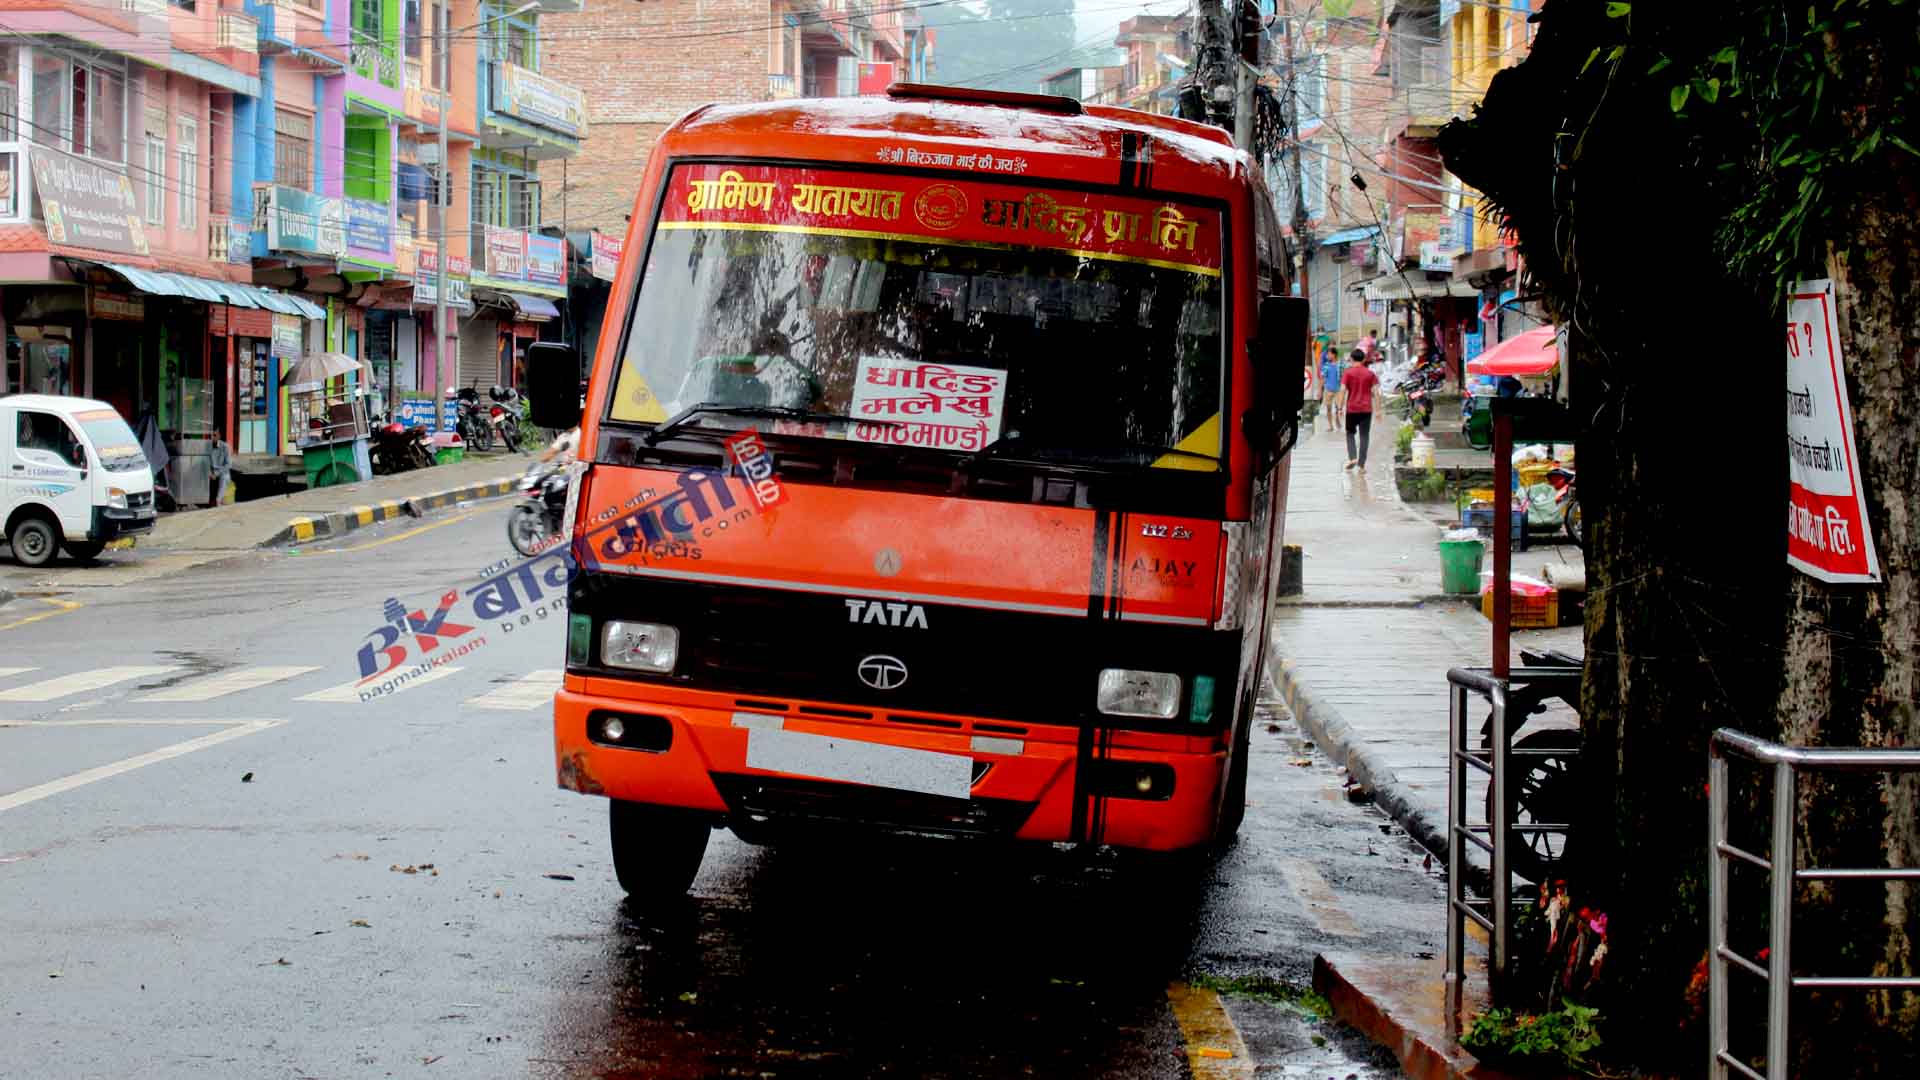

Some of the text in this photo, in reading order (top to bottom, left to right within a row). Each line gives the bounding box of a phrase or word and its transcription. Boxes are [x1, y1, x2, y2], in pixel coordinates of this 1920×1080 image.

[792, 184, 904, 221] यातायात
[861, 392, 994, 418] मलेखु
[1131, 558, 1197, 577] AJAY
[845, 599, 928, 629] TATA
